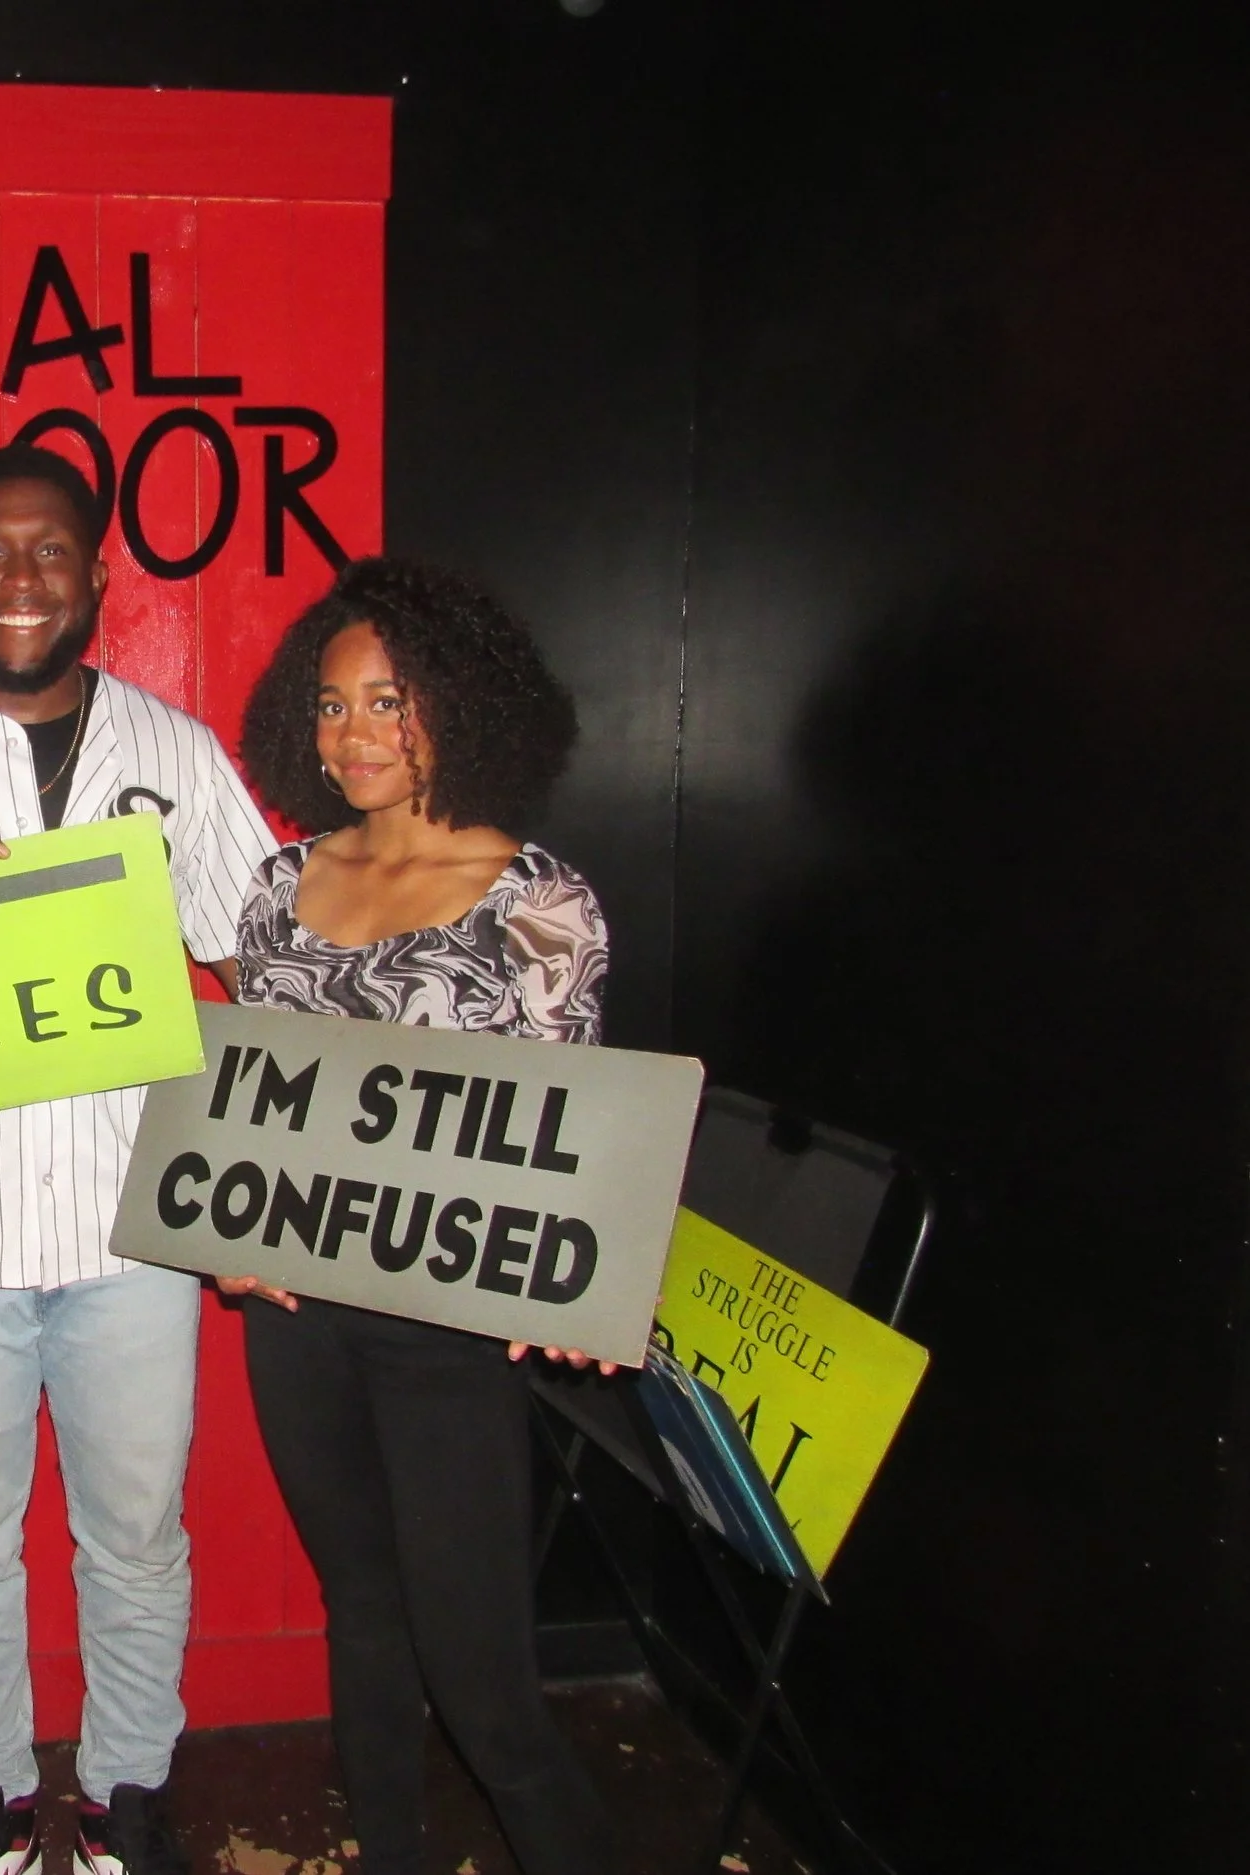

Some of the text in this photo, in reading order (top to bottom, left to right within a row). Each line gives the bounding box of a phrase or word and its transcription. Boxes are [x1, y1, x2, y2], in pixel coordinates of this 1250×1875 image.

[207, 1045, 580, 1175] I'M STILL
[156, 1151, 599, 1305] CONFUSED
[691, 1267, 837, 1382] STRUGGLE
[748, 1258, 806, 1315] THE
[729, 1336, 759, 1375] IS
